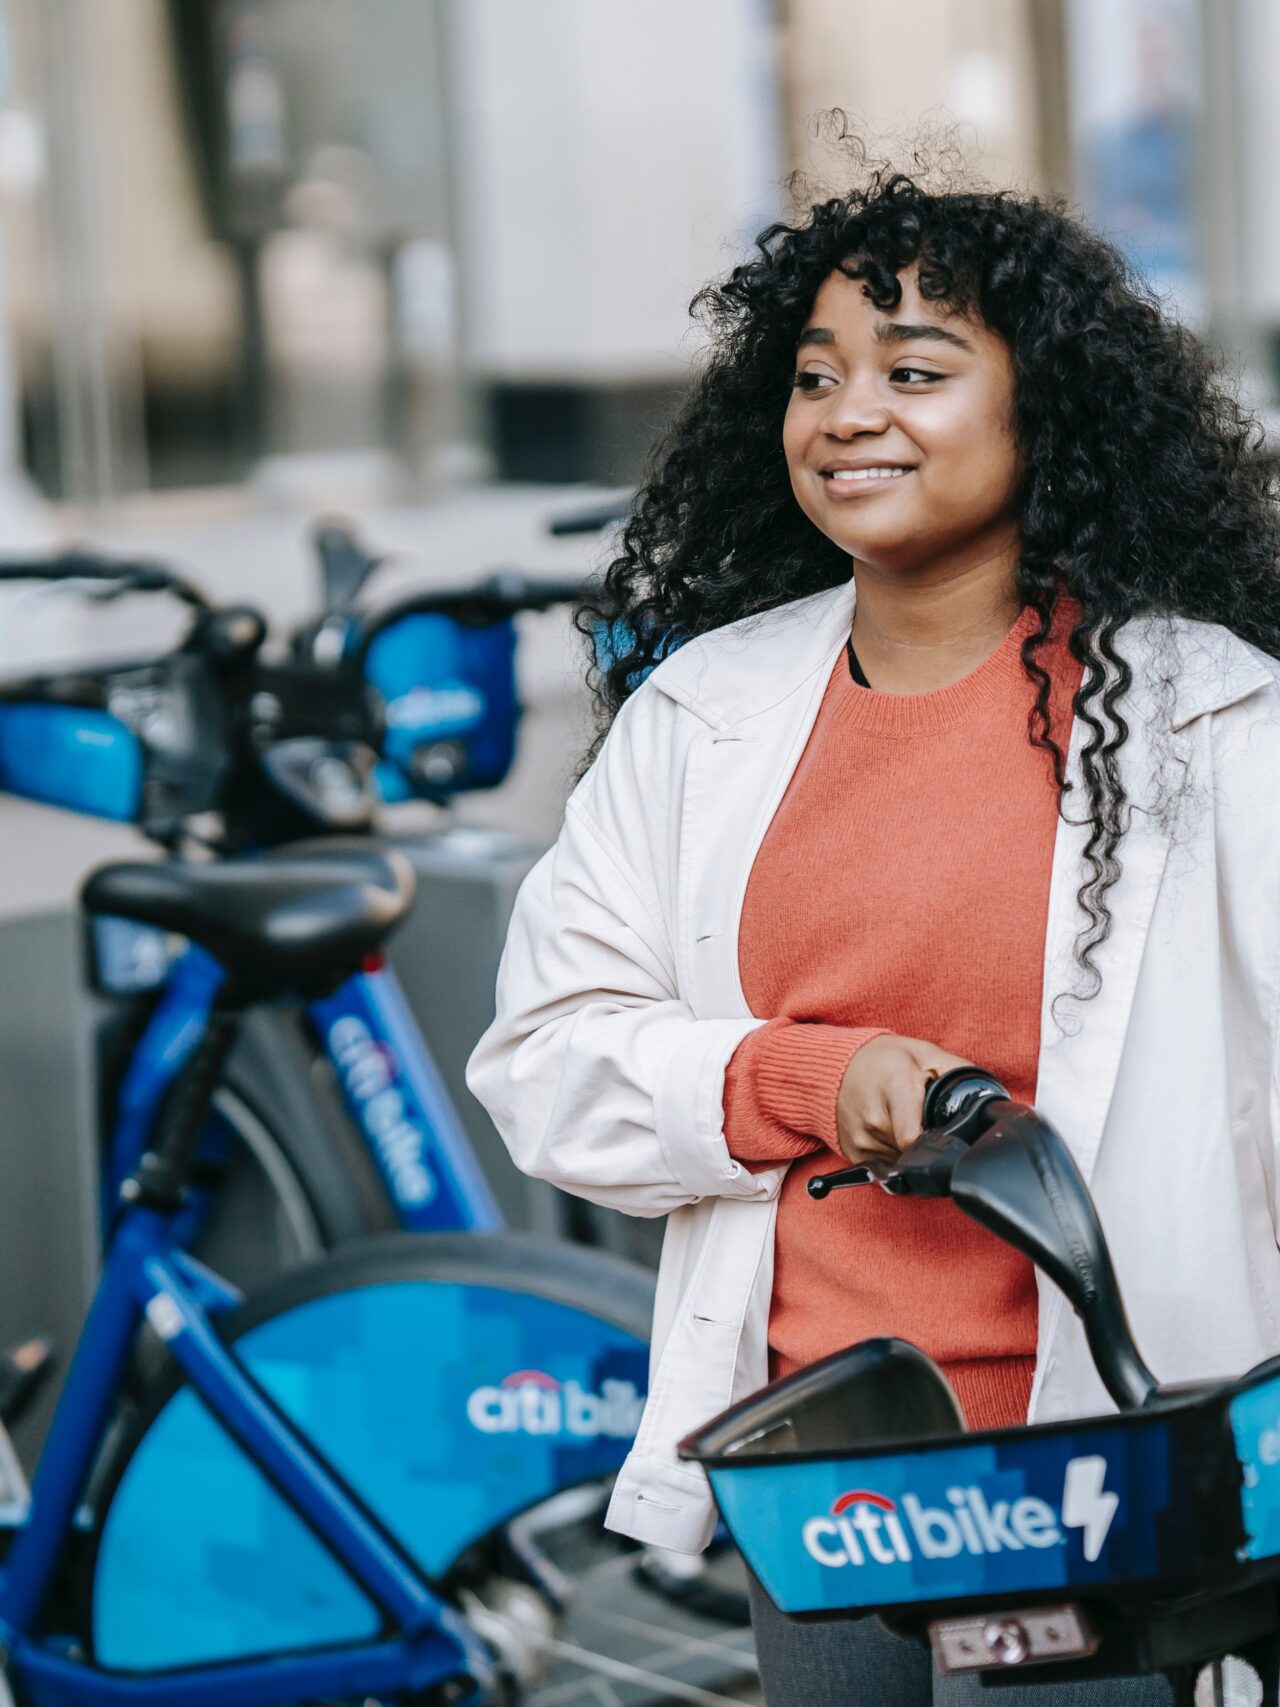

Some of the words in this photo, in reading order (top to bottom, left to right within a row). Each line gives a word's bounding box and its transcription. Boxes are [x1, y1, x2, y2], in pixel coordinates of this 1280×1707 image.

[466, 1370, 561, 1435] citi
[564, 1379, 650, 1438] bik
[802, 1491, 911, 1568] citi
[901, 1485, 1062, 1559] bike
